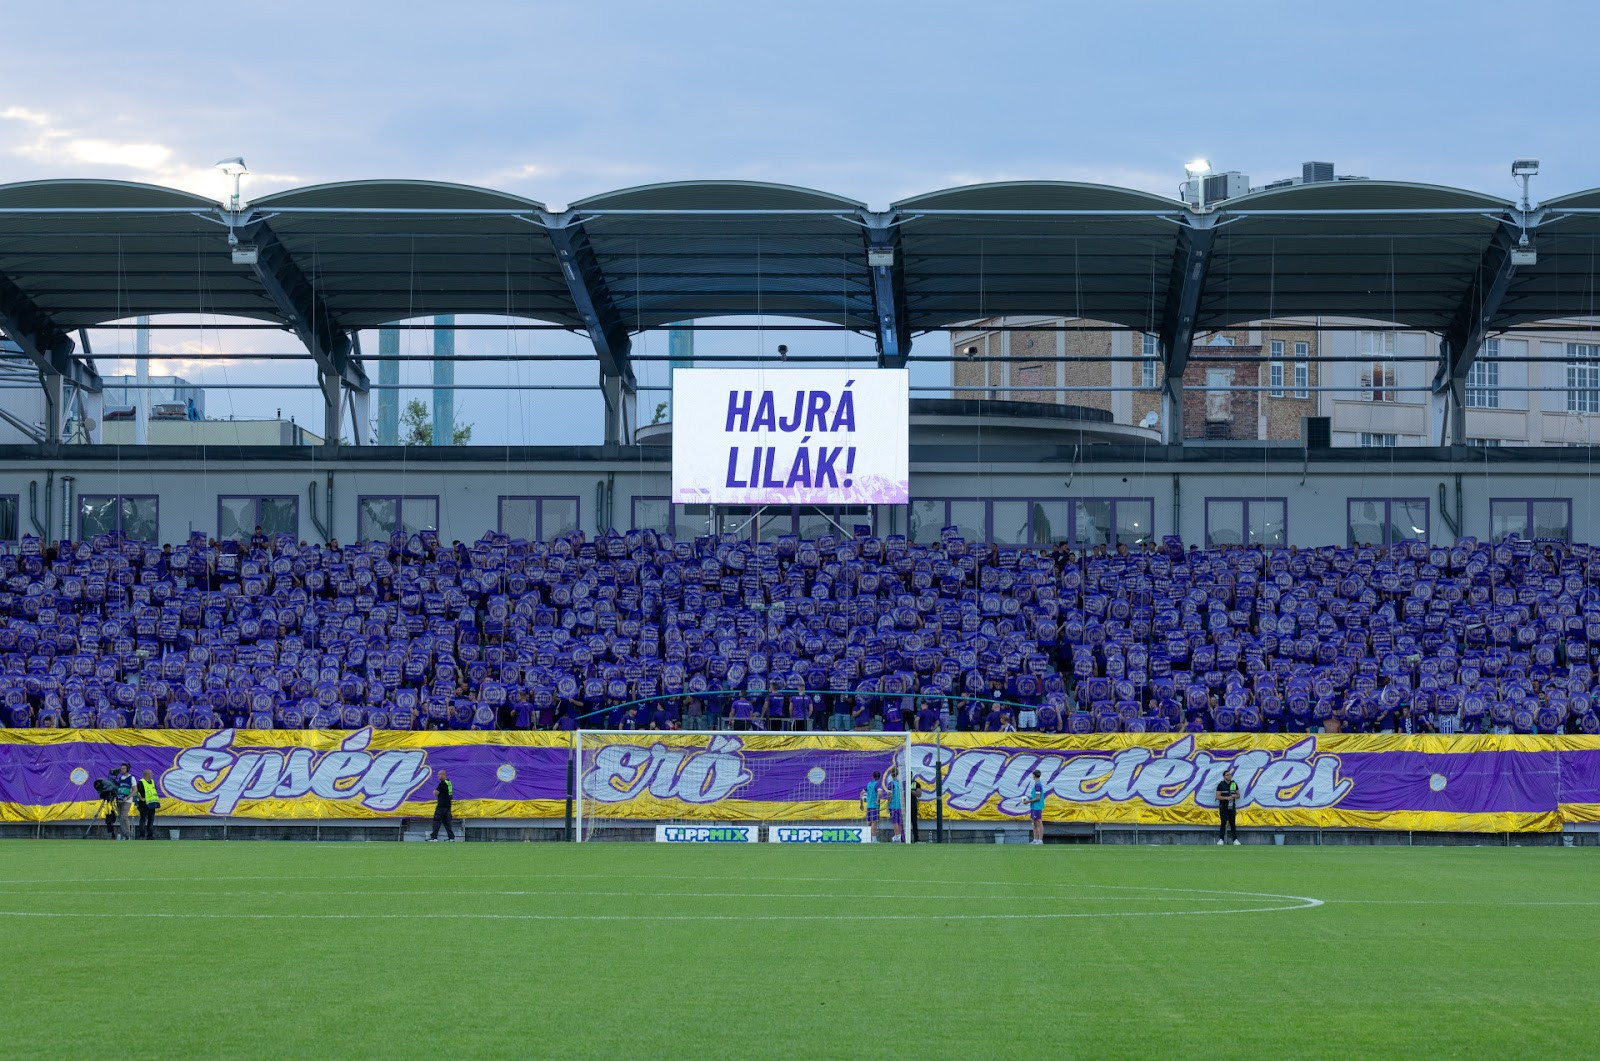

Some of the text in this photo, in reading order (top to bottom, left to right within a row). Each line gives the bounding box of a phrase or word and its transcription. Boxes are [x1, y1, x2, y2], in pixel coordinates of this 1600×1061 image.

[725, 380, 856, 433] HAJRÁ
[725, 436, 856, 488] LILÁK!
[1414, 546, 1424, 555] 140
[1499, 551, 1509, 559] 140
[174, 555, 184, 564] 140
[357, 558, 367, 567] 140
[1434, 554, 1444, 563] 140
[310, 577, 320, 585] 140
[358, 574, 368, 583] 140
[485, 575, 494, 584] 140
[864, 578, 874, 587] 140
[918, 577, 928, 585] 140
[68, 583, 78, 592] 140
[1418, 587, 1428, 596] 140
[556, 591, 566, 600] 140
[986, 601, 997, 610] 140
[1006, 601, 1016, 610] 140
[1116, 606, 1126, 614] 140
[282, 613, 292, 622] 140
[903, 613, 913, 622] 140
[1214, 615, 1224, 624] 140
[106, 626, 116, 634] 140
[246, 624, 256, 633] 140
[625, 624, 635, 632] 140
[556, 632, 566, 640] 140
[1522, 630, 1532, 639] 140
[194, 650, 205, 659] 140
[962, 653, 972, 662] 140
[1132, 654, 1142, 664] 140
[1540, 651, 1550, 660] 140
[78, 661, 88, 670] 140
[753, 658, 763, 667] 140
[1488, 659, 1498, 668] 140
[324, 671, 335, 680] 140
[440, 668, 450, 677] 140
[1209, 672, 1219, 681] 140
[612, 683, 623, 692] 140
[1021, 682, 1032, 691] 140
[121, 690, 132, 698] 140
[257, 698, 268, 706] 140
[401, 696, 412, 705] 140
[1468, 700, 1479, 710] 140
[162, 726, 431, 814] Épség
[582, 735, 752, 804] Erő
[885, 735, 1353, 815] Egyetértés
